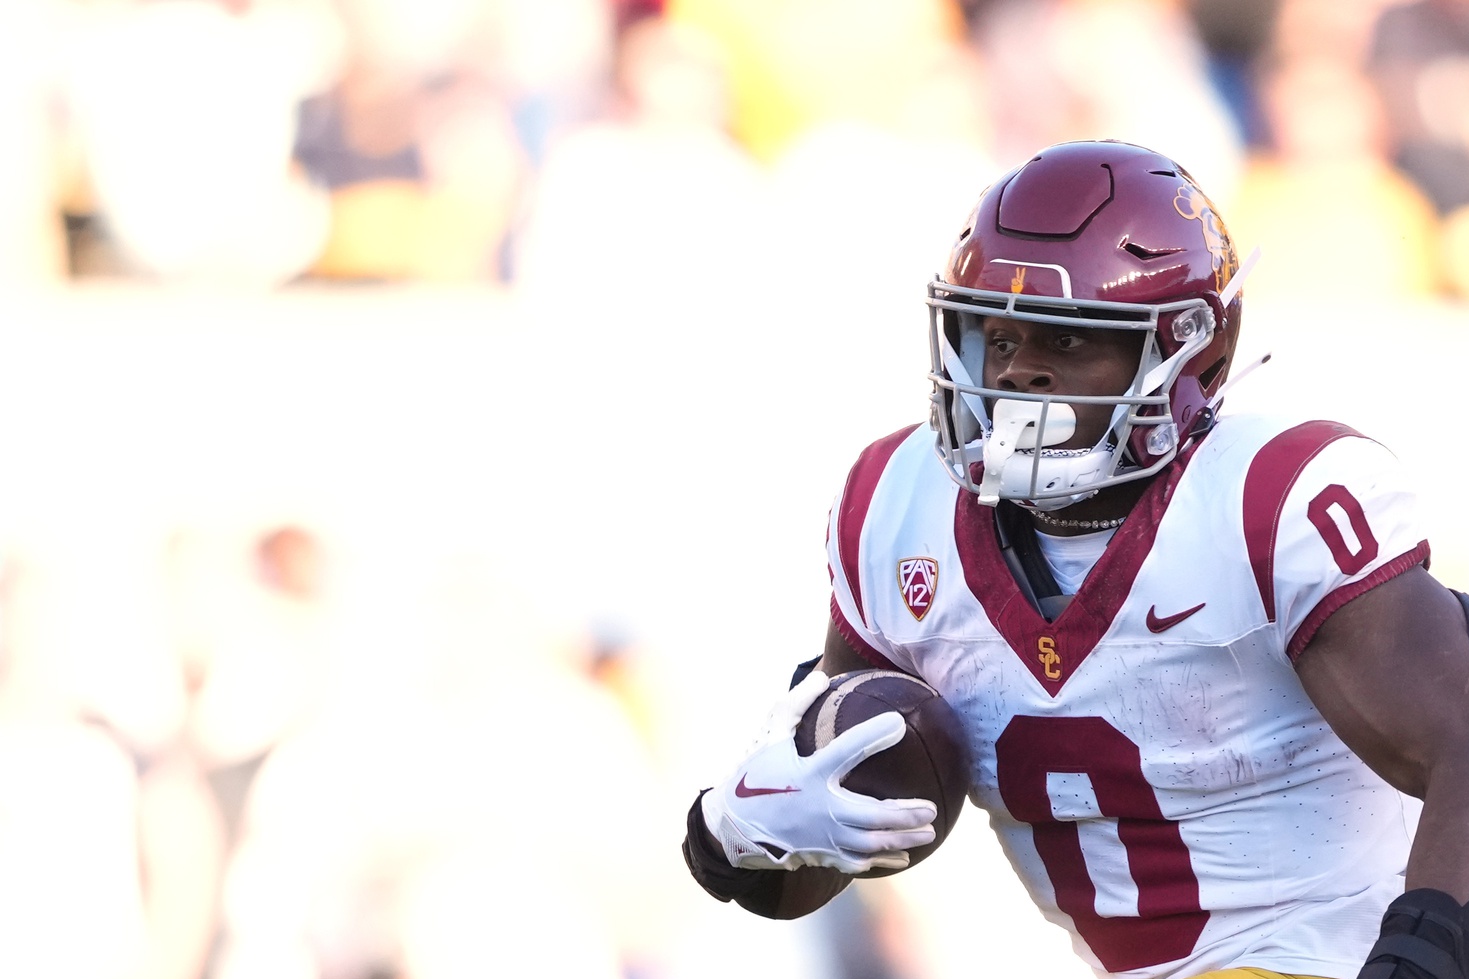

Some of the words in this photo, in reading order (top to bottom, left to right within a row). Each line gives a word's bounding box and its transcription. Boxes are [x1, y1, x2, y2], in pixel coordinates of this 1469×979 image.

[1307, 483, 1378, 575] 0
[900, 559, 936, 595] PAC
[908, 583, 928, 606] 12
[1038, 637, 1060, 679] SC
[995, 715, 1210, 972] 0
